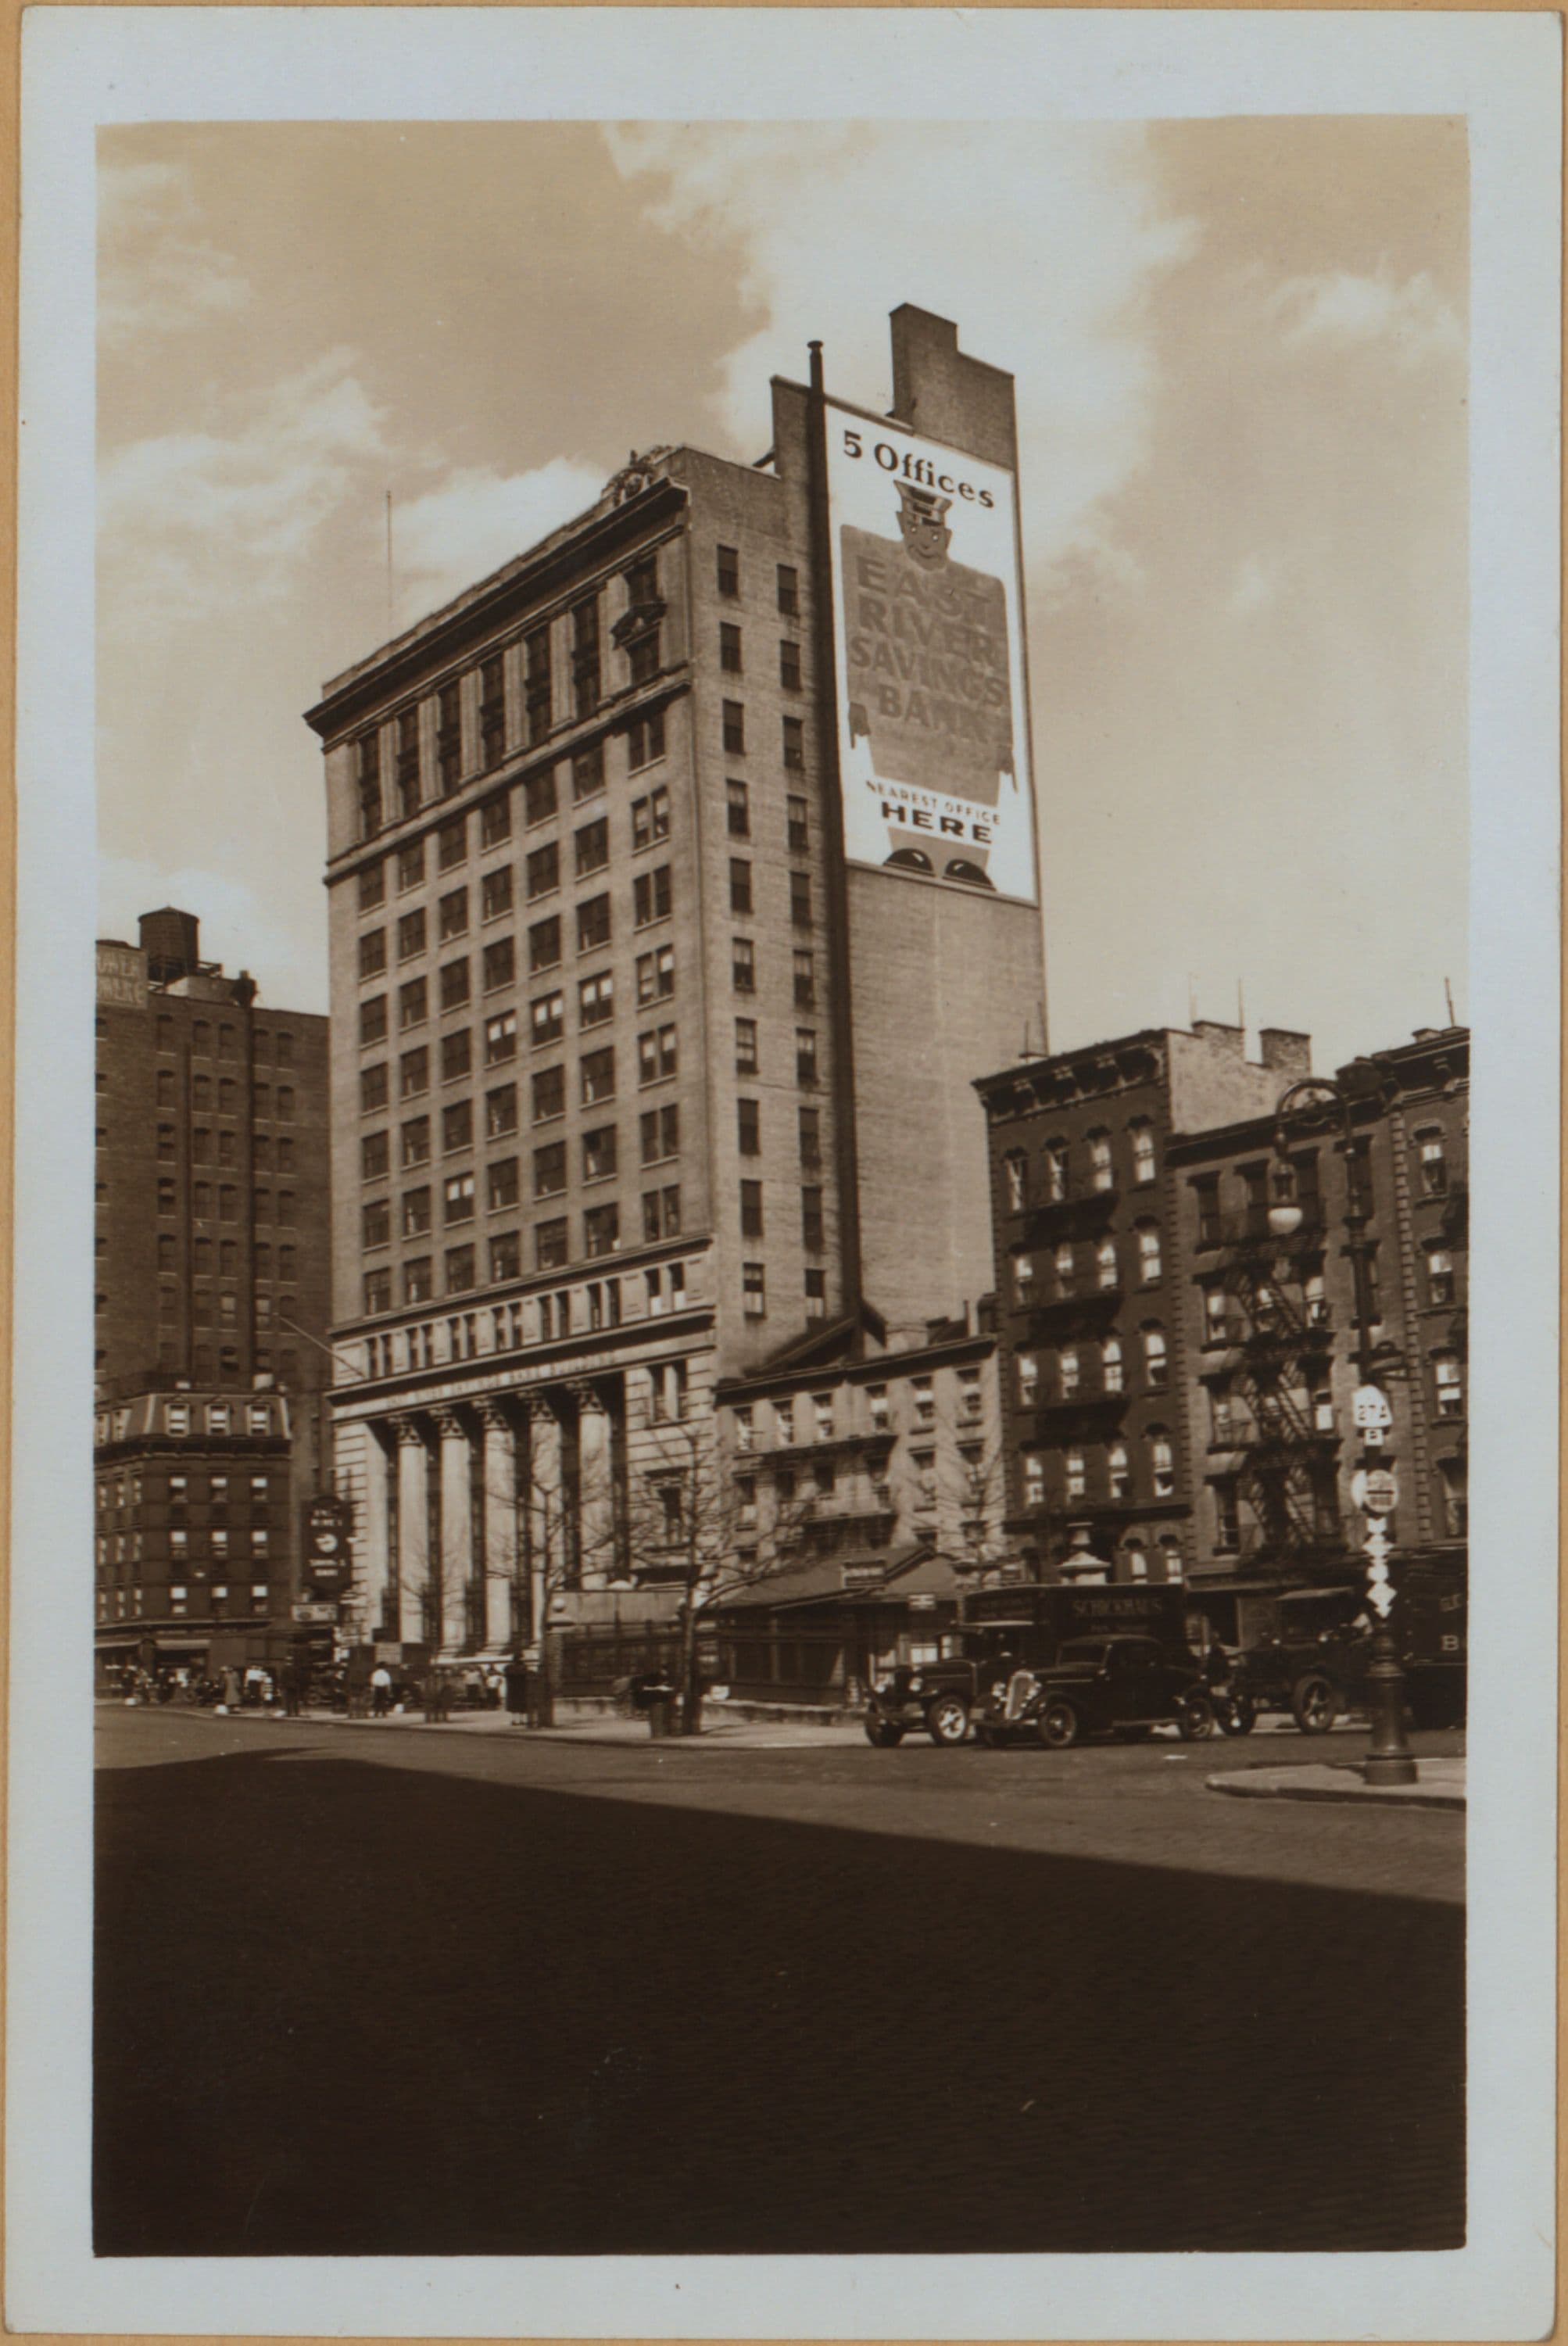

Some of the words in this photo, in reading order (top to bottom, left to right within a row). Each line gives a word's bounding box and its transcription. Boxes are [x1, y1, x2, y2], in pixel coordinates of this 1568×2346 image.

[843, 430, 862, 459] 5
[873, 442, 994, 509] Offices
[857, 555, 991, 626] EAST
[858, 595, 997, 666] RIVER
[850, 635, 1008, 707] SAVINGS
[866, 780, 937, 808] NEAREST
[945, 801, 1001, 826] OFFICE
[882, 801, 992, 844] HERE
